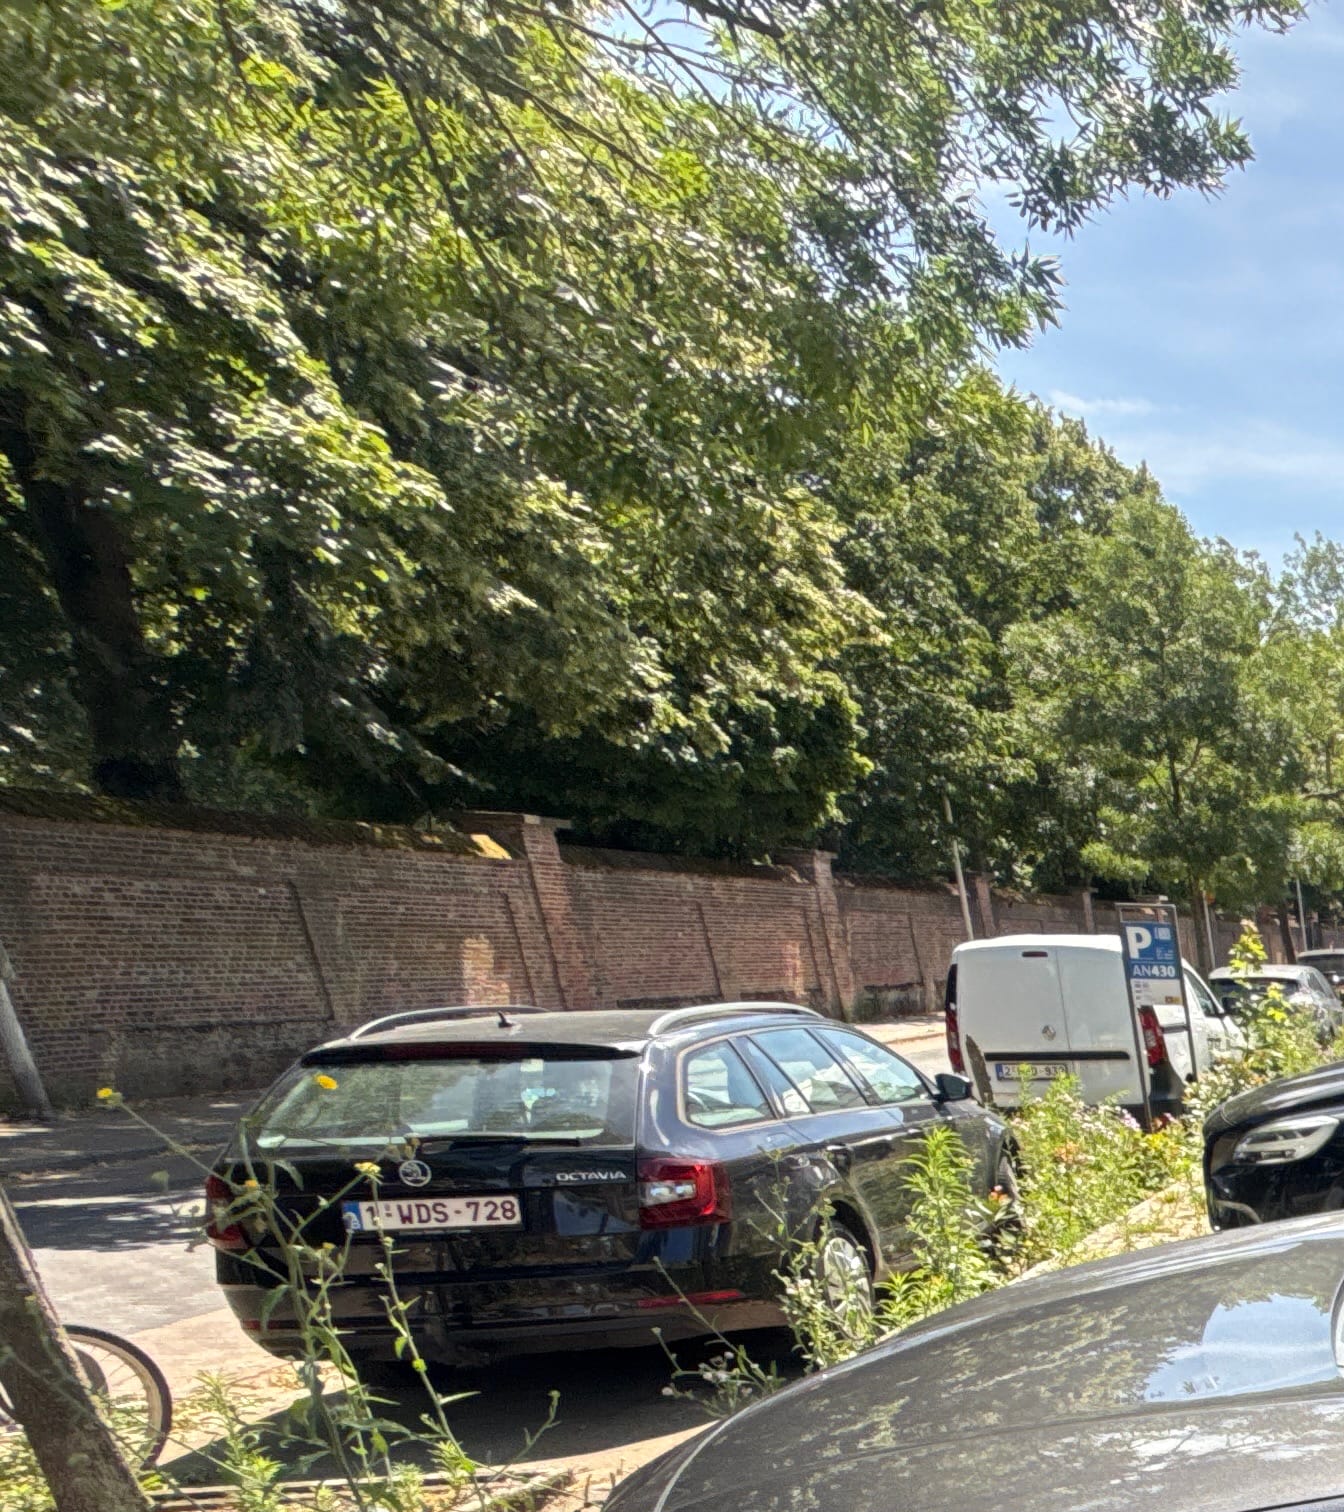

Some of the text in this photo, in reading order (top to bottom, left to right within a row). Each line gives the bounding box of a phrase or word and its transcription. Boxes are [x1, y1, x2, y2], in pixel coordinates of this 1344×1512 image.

[1125, 926, 1152, 959] P
[1132, 964, 1176, 977] AN430
[556, 1170, 627, 1182] OCTAVIA
